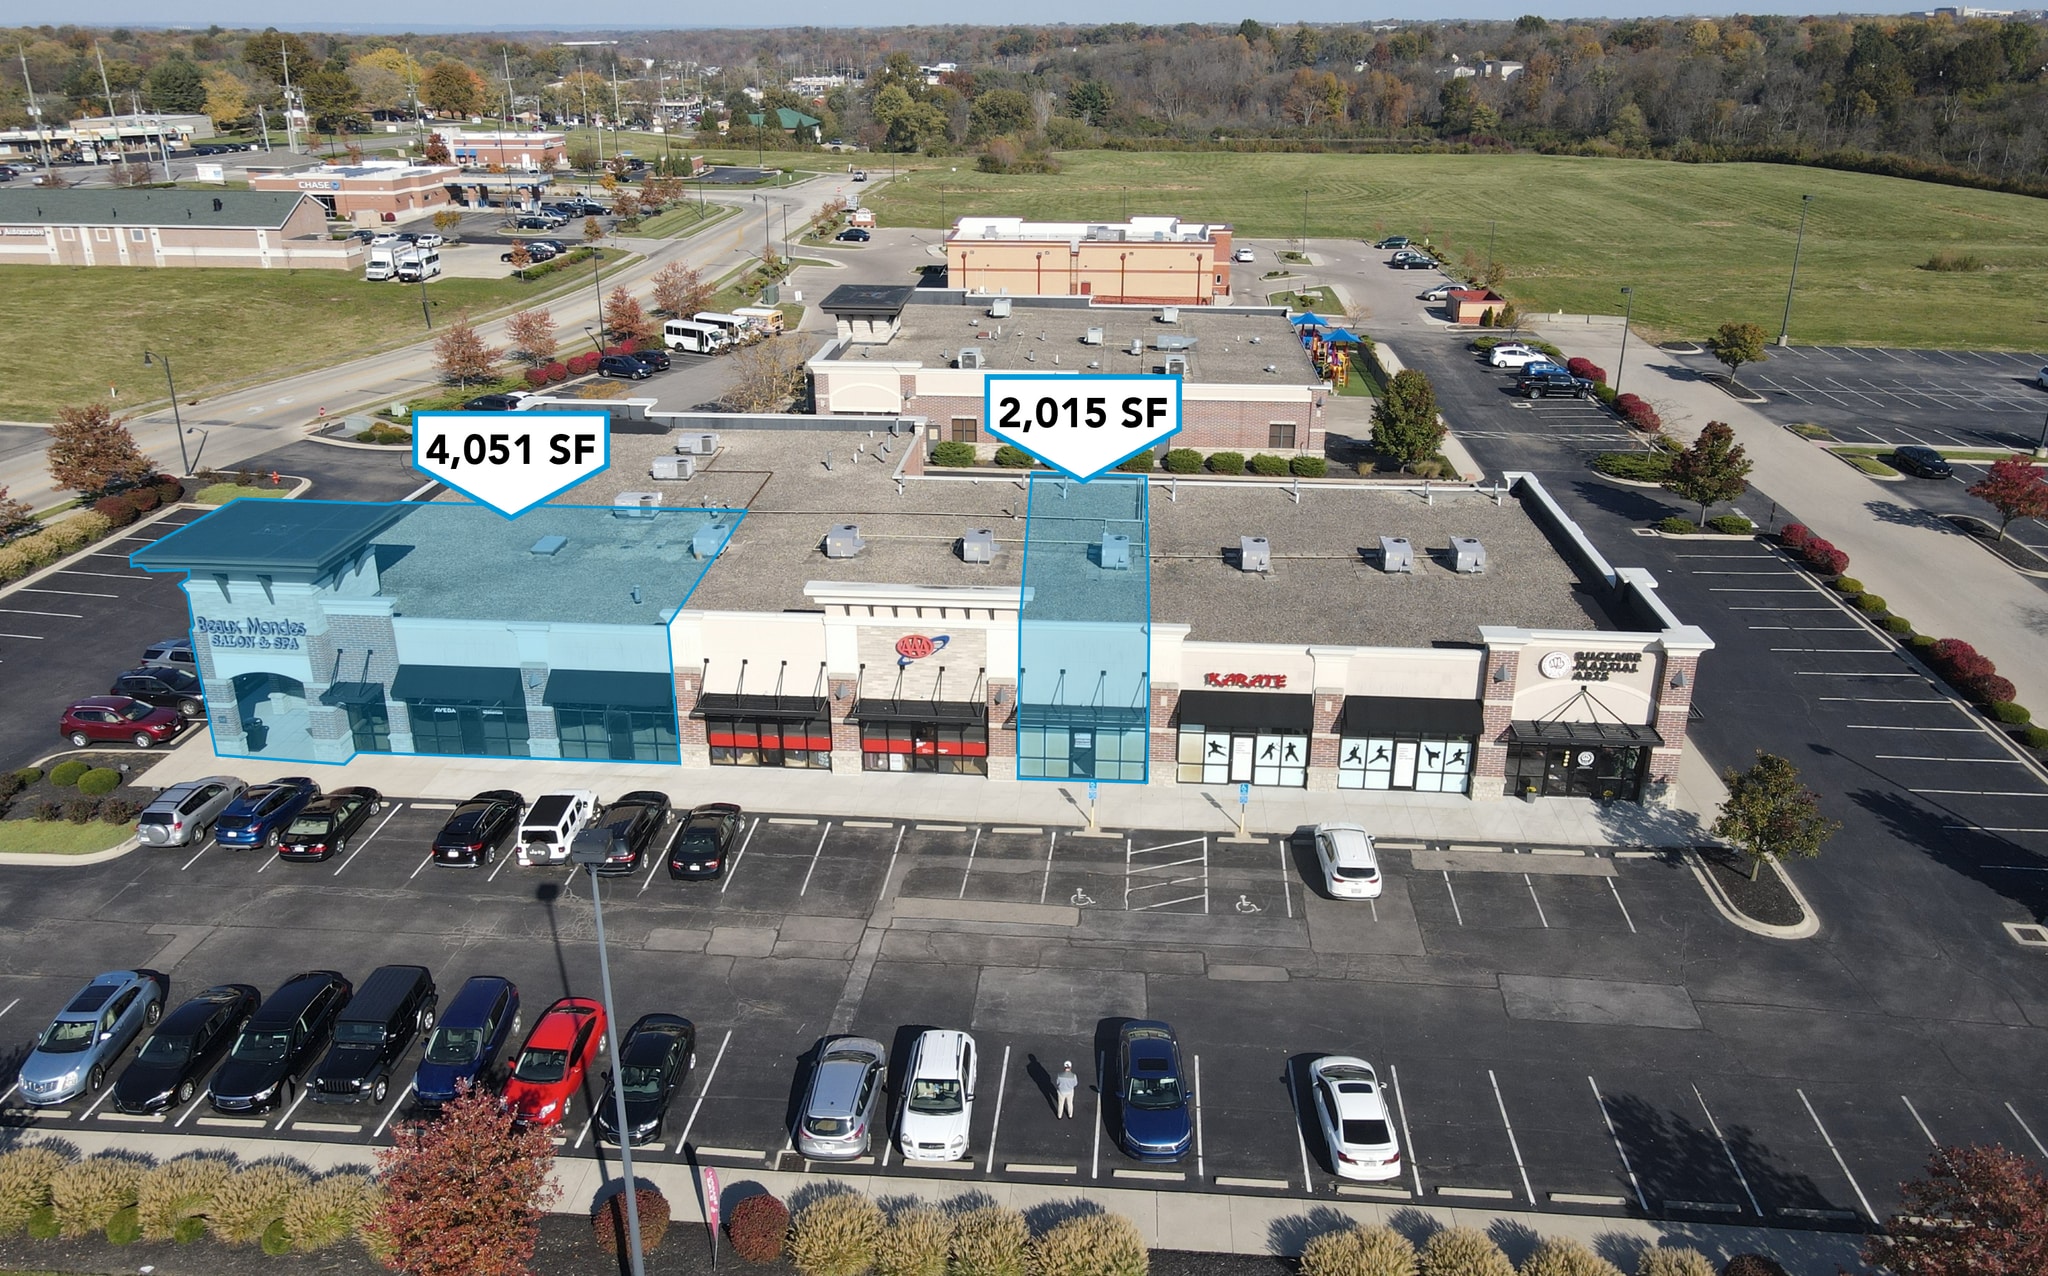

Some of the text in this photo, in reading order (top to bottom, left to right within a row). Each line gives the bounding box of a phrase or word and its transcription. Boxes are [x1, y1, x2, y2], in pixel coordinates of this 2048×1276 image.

[298, 181, 331, 189] CHASE
[197, 616, 307, 636] Beaux Mondes
[212, 635, 299, 650] SALON & SPA
[899, 637, 932, 657] AAA
[1572, 661, 1638, 673] MARTIAL
[1204, 672, 1287, 689] KARATE
[1572, 671, 1609, 681] ARTS
